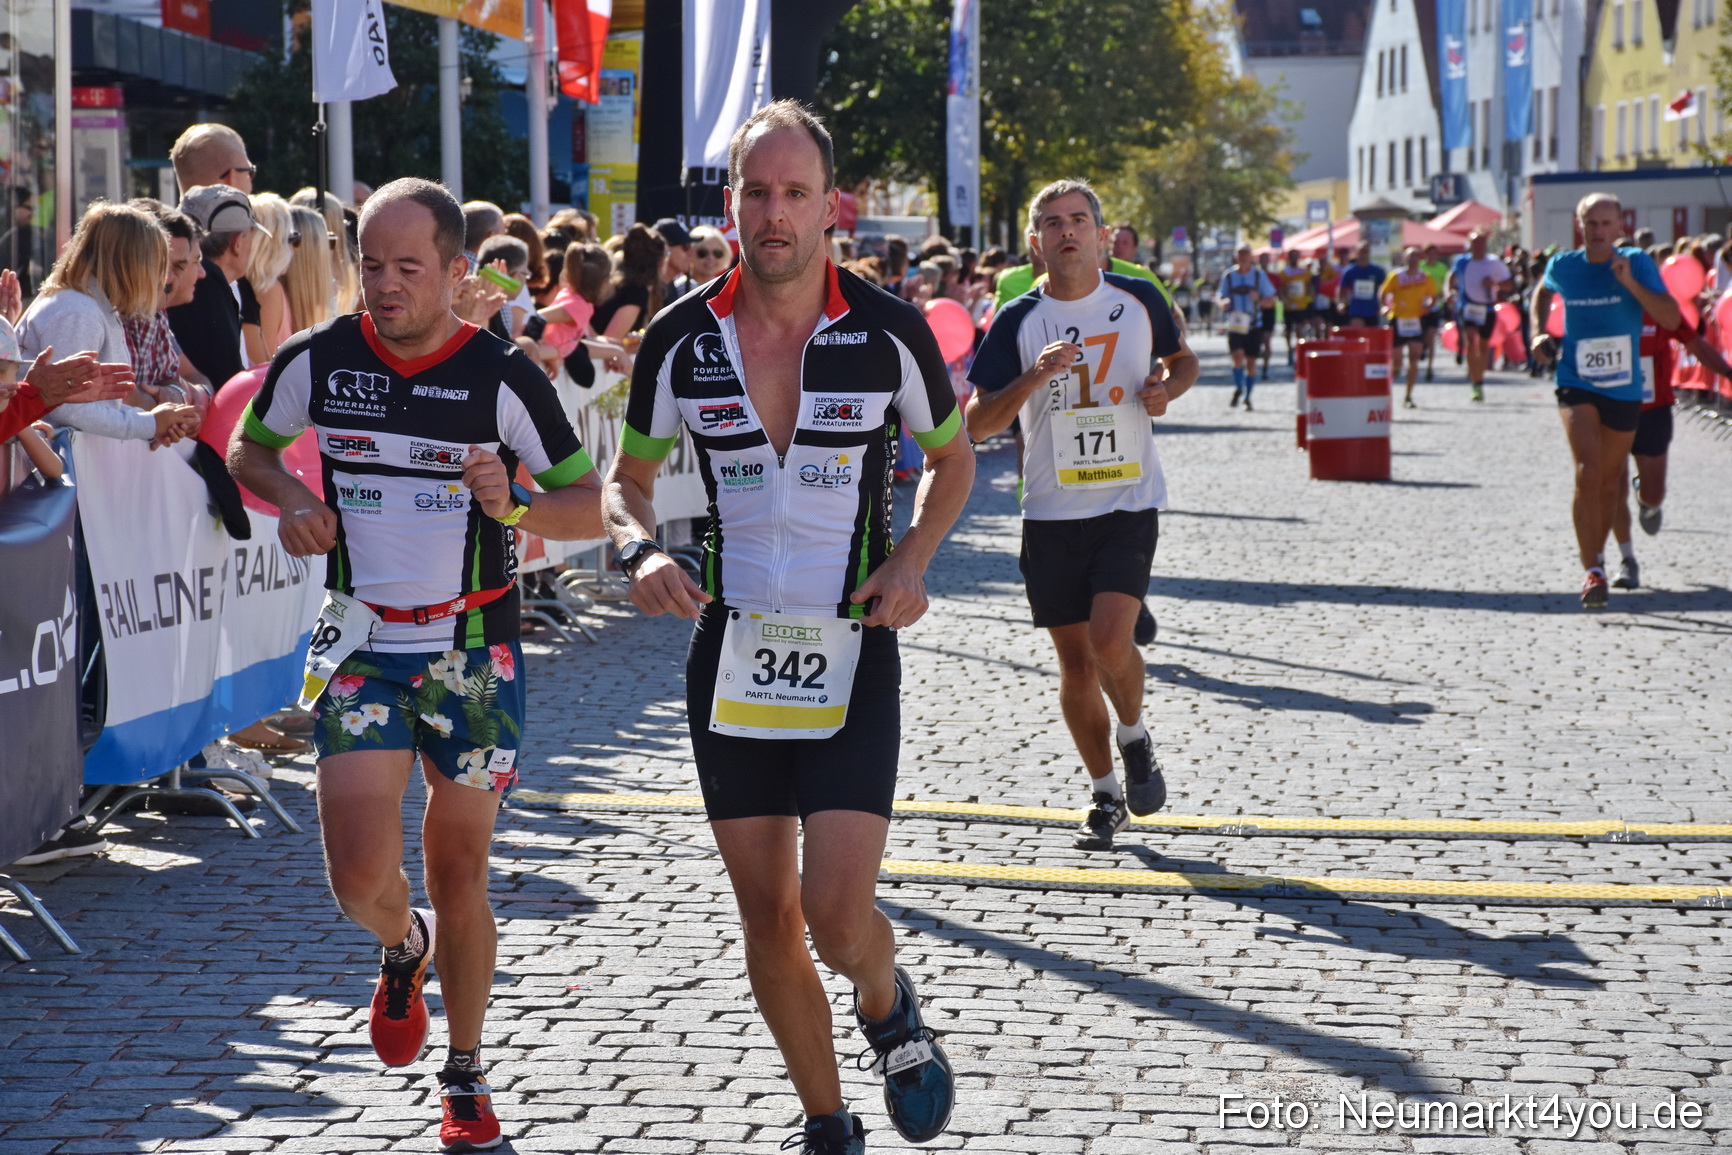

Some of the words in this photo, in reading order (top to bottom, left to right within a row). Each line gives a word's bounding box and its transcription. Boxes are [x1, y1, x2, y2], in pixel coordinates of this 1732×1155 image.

[813, 333, 828, 346] BIO
[841, 331, 867, 346] RACER
[1585, 351, 1622, 368] 2611
[412, 385, 428, 397] BIO
[441, 388, 469, 401] RACER
[323, 406, 386, 418] Rednitzhembach
[699, 406, 748, 422] GREIL
[813, 404, 863, 421] ROCK
[1076, 414, 1115, 426] BOCK
[327, 437, 380, 453] GREIL
[410, 441, 464, 453] ELEKTROMOTOREN
[1074, 429, 1116, 456] 171
[410, 446, 463, 465] ROCK
[1092, 457, 1117, 465] Neumarkt
[1078, 469, 1123, 482] Matthias
[742, 485, 764, 493] Brandt
[360, 508, 382, 516] Brandt
[101, 566, 214, 640] RAIL.ONE
[762, 623, 822, 642] BOCK
[752, 648, 828, 690] 342
[745, 690, 774, 700] PARTL
[776, 693, 816, 703] Neumarkt
